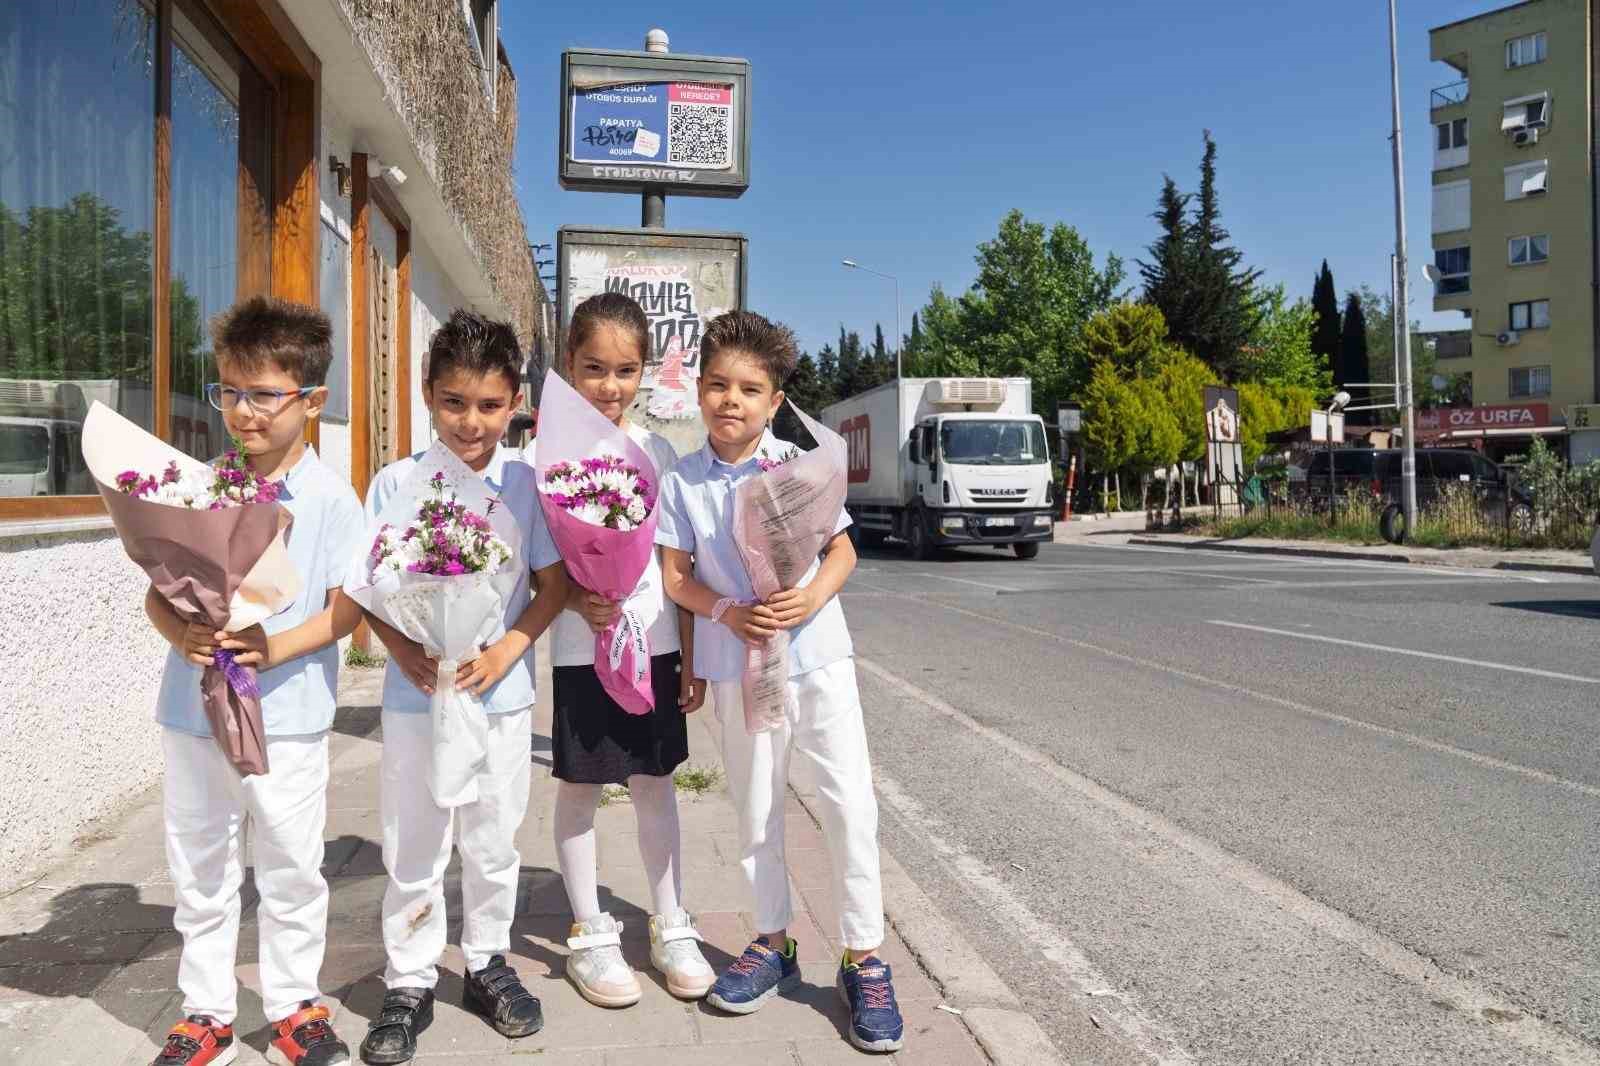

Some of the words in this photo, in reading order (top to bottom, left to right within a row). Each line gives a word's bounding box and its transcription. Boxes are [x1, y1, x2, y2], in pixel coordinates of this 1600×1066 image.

[623, 95, 657, 103] DURAĞI
[600, 118, 643, 128] PAPATYA
[1450, 410, 1475, 425] ÖZ
[1481, 408, 1534, 423] URFA
